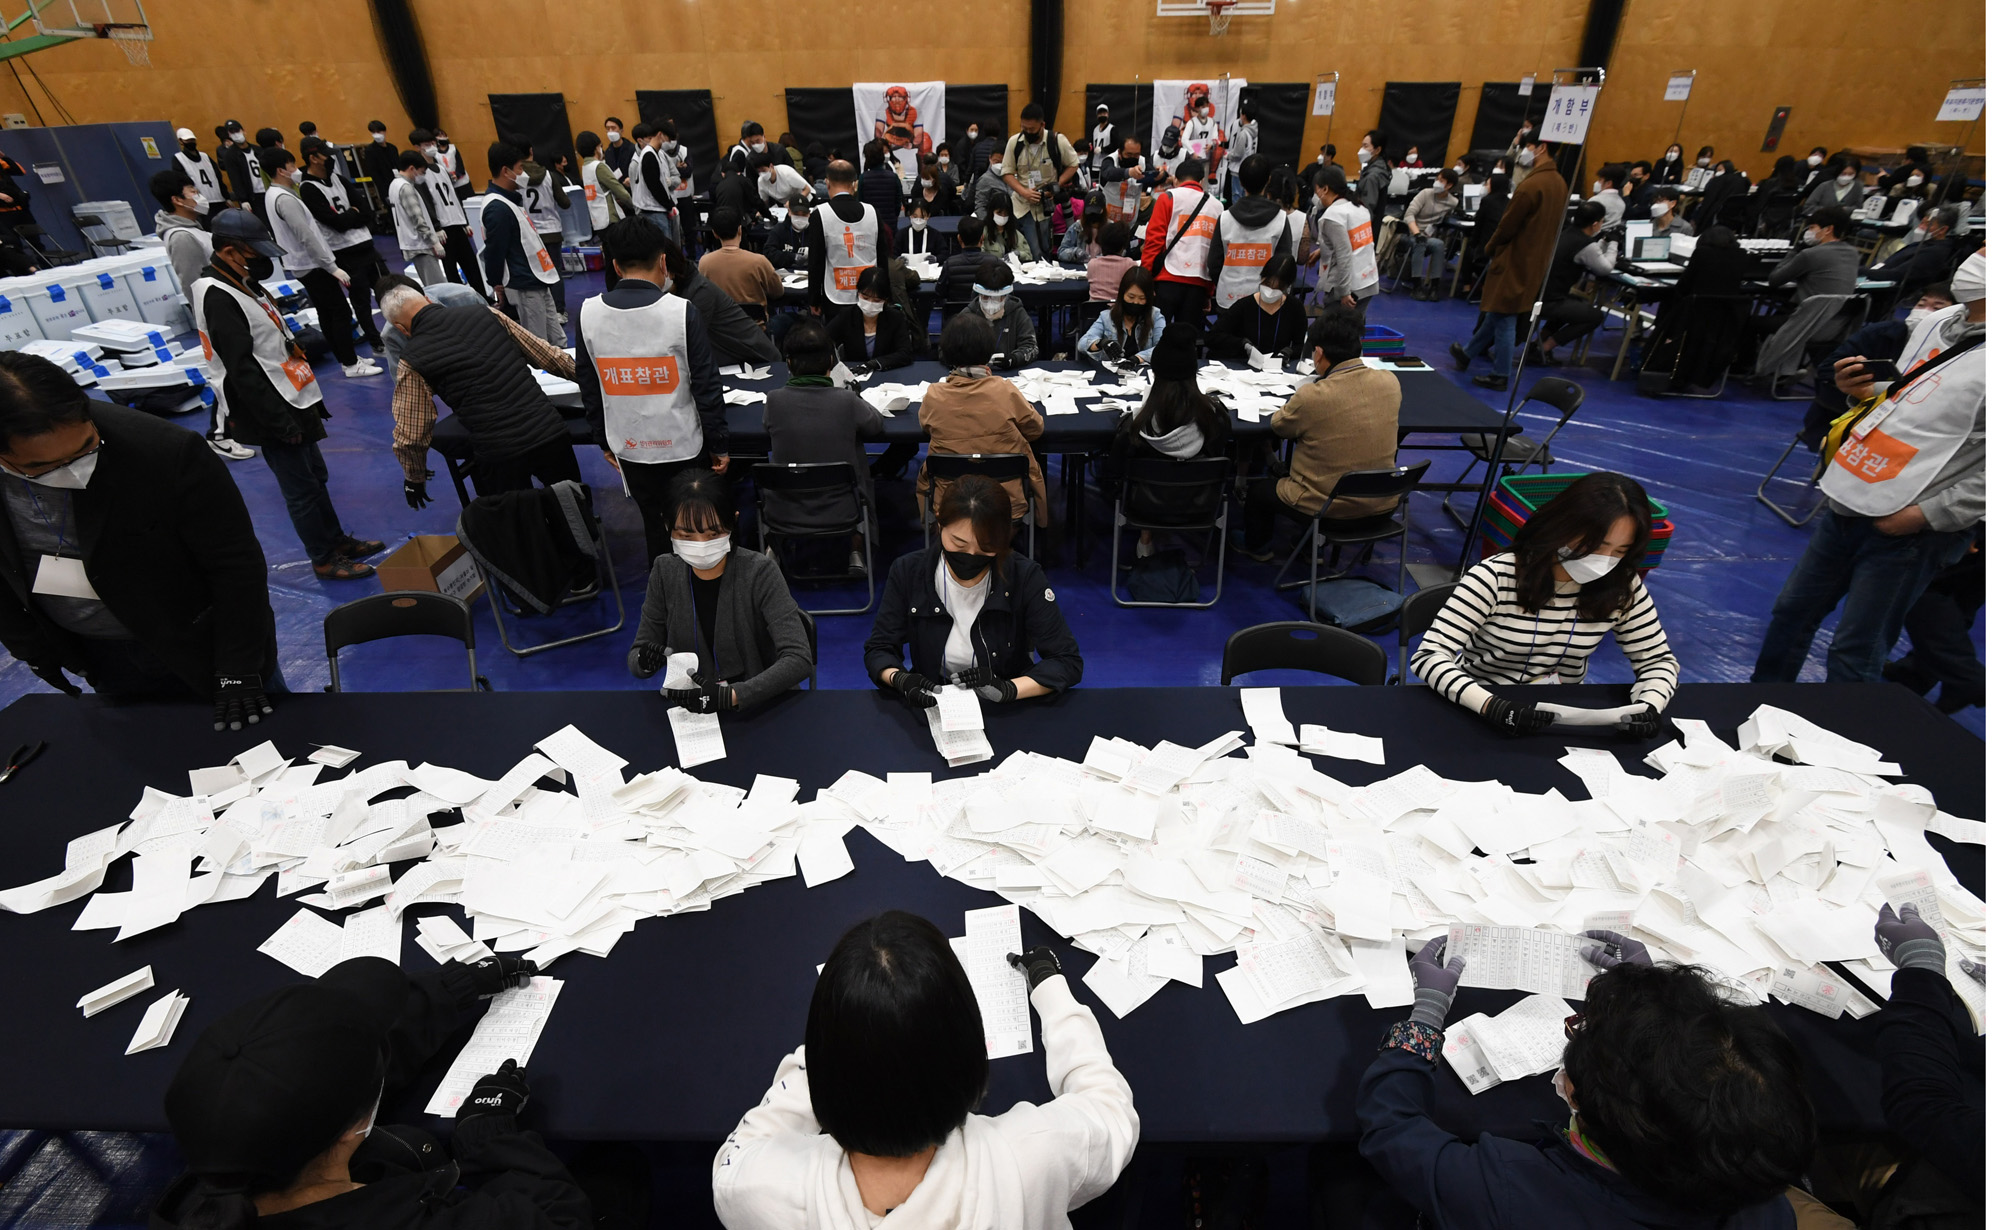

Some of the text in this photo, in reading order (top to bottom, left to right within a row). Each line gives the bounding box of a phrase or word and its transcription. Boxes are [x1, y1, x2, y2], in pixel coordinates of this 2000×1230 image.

[199, 169, 213, 188] 4
[249, 160, 261, 178] 6
[526, 188, 542, 214] 2
[1226, 248, 1267, 260] 개표참관
[604, 366, 670, 385] 개표참관
